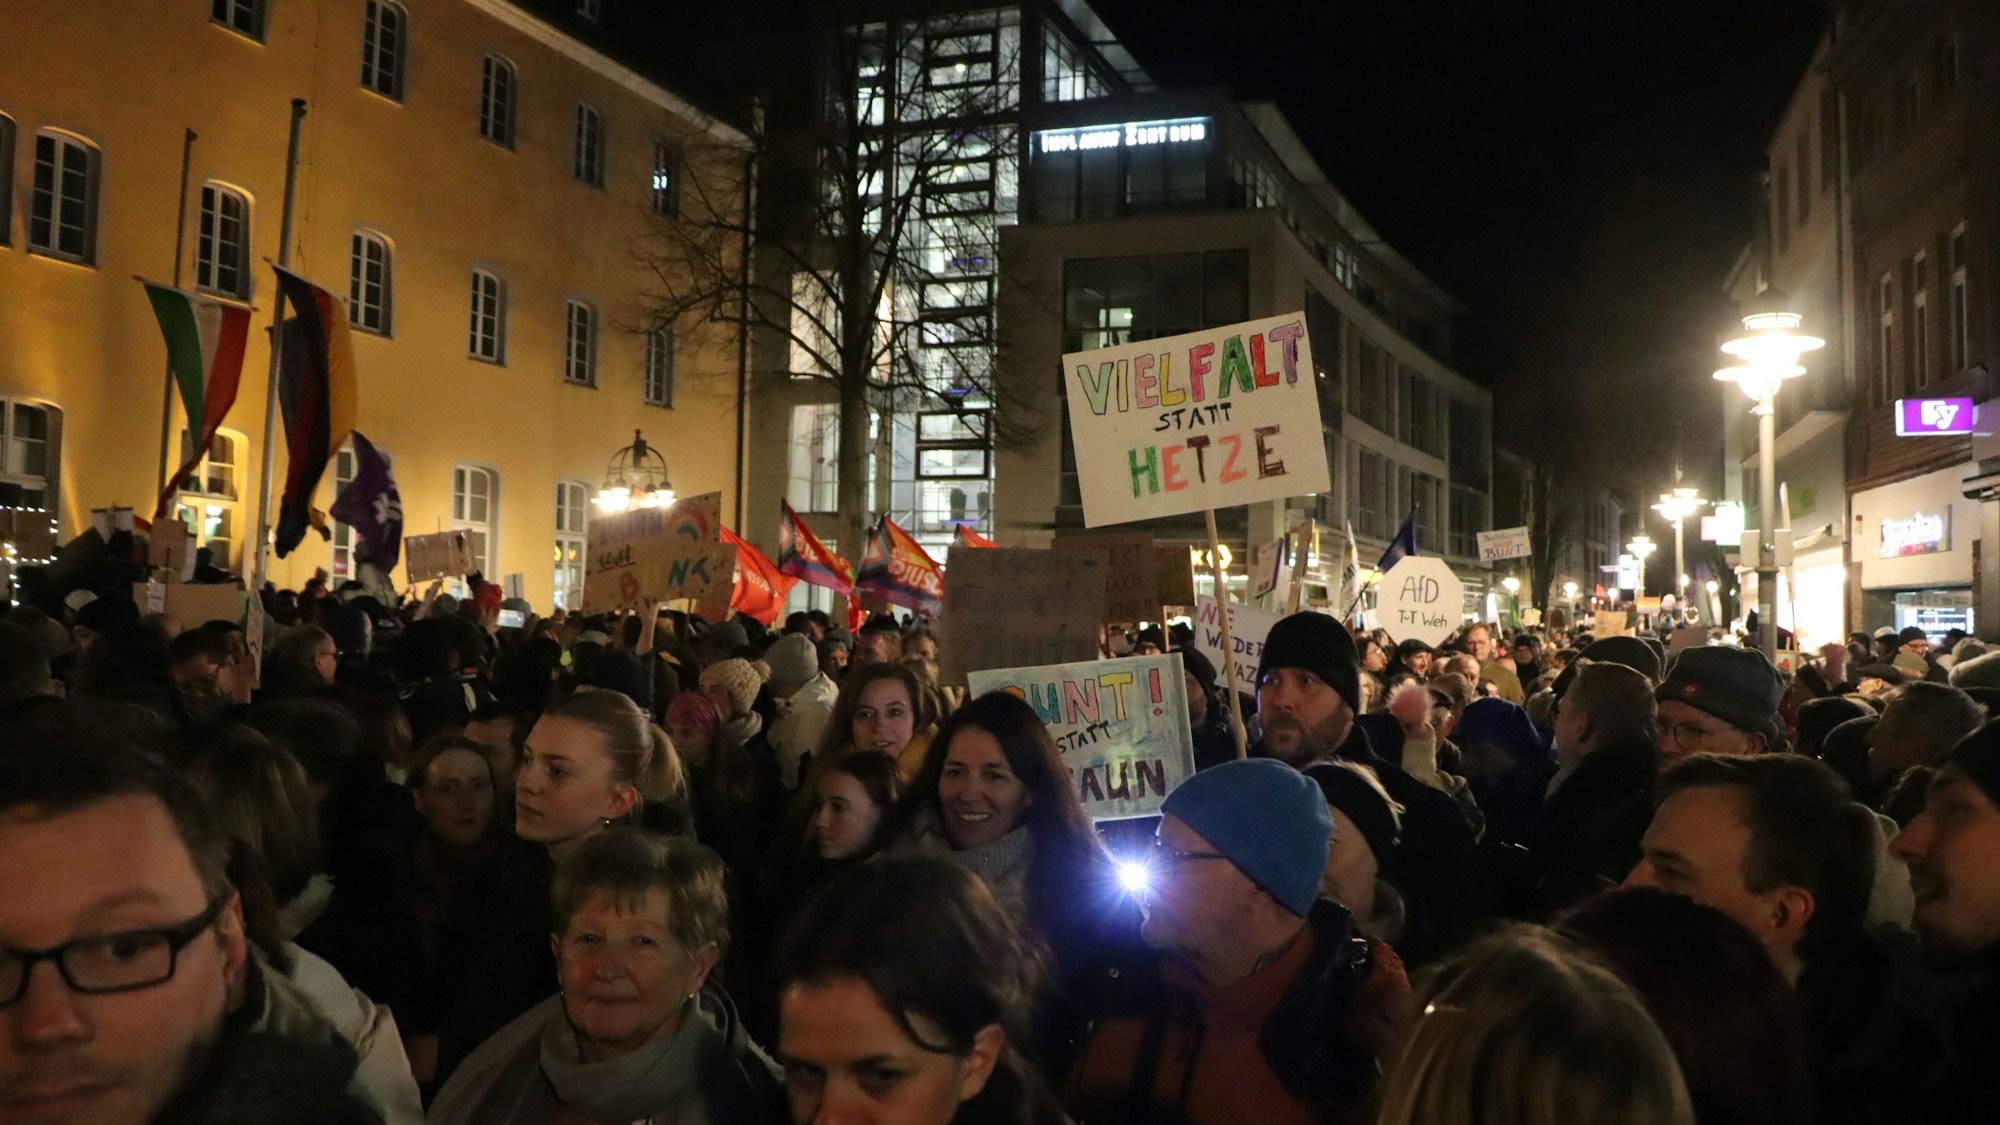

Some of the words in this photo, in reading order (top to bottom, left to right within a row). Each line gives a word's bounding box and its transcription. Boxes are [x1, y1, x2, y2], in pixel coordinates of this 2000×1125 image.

[1076, 320, 1304, 415] VIELFALT
[1153, 402, 1232, 432] STATT
[1128, 425, 1290, 498] HETZE
[1108, 543, 1142, 566] IERT
[1484, 543, 1525, 559] BUNT
[1400, 575, 1439, 604] AfD
[1397, 609, 1418, 625] TuT
[1421, 610, 1448, 628] Weh
[1003, 668, 1163, 724] UNT!
[1055, 720, 1111, 754] STATT
[1080, 758, 1165, 803] AUN
